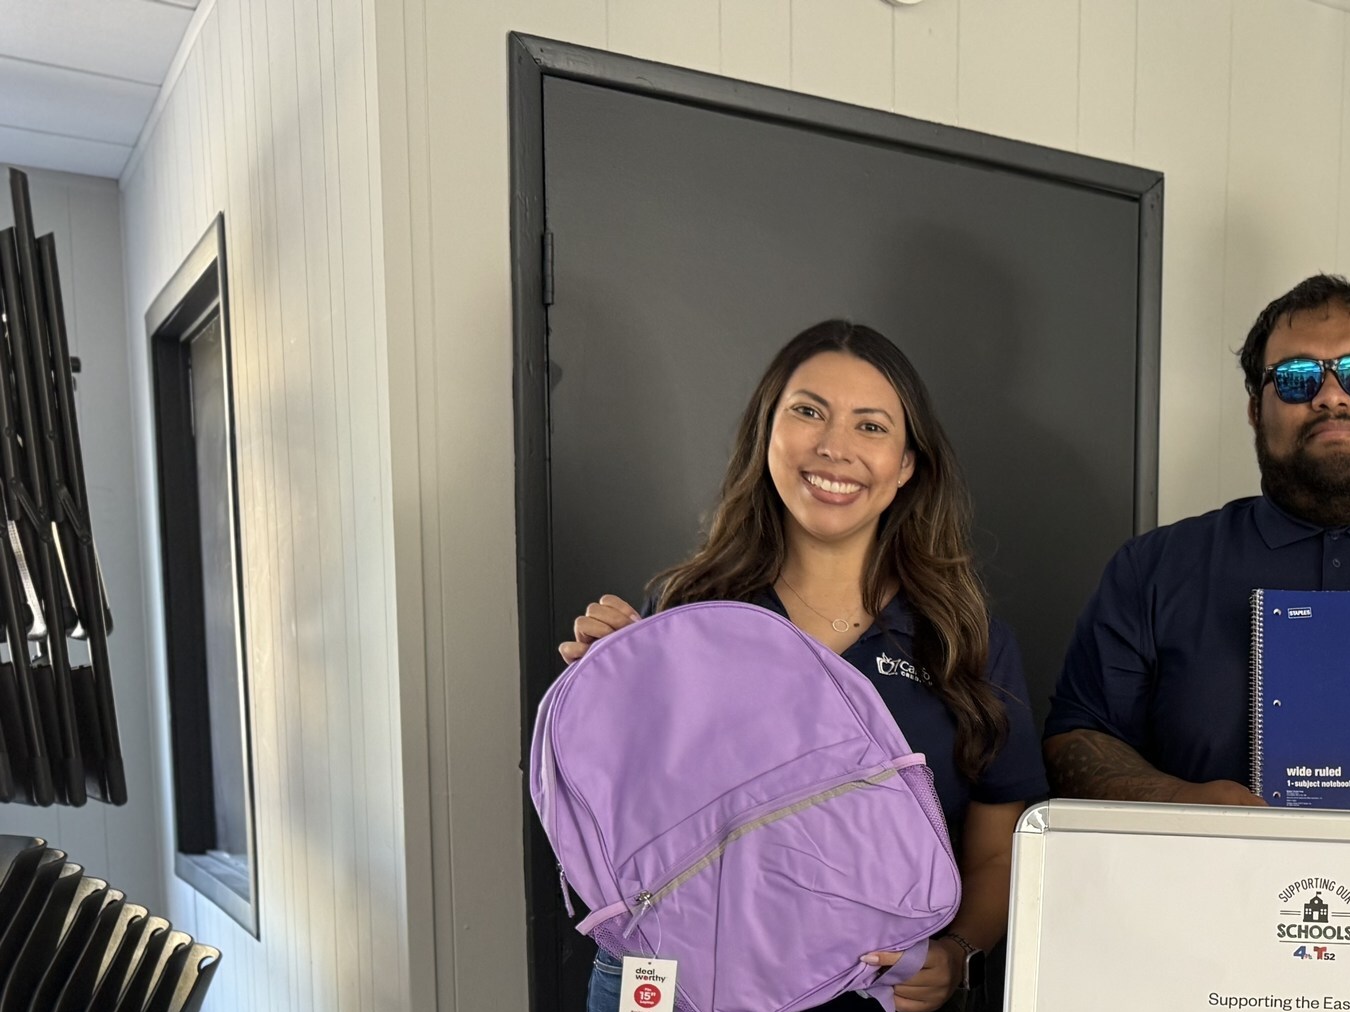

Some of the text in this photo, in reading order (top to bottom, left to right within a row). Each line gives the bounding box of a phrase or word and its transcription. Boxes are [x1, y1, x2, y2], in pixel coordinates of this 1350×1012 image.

[1287, 766, 1341, 776] wide ruled
[1287, 780, 1320, 788] 1-subject
[1279, 878, 1336, 902] SUPPORTING
[636, 974, 665, 982] worthy
[1209, 993, 1292, 1011] Supporting
[1296, 996, 1319, 1009] the
